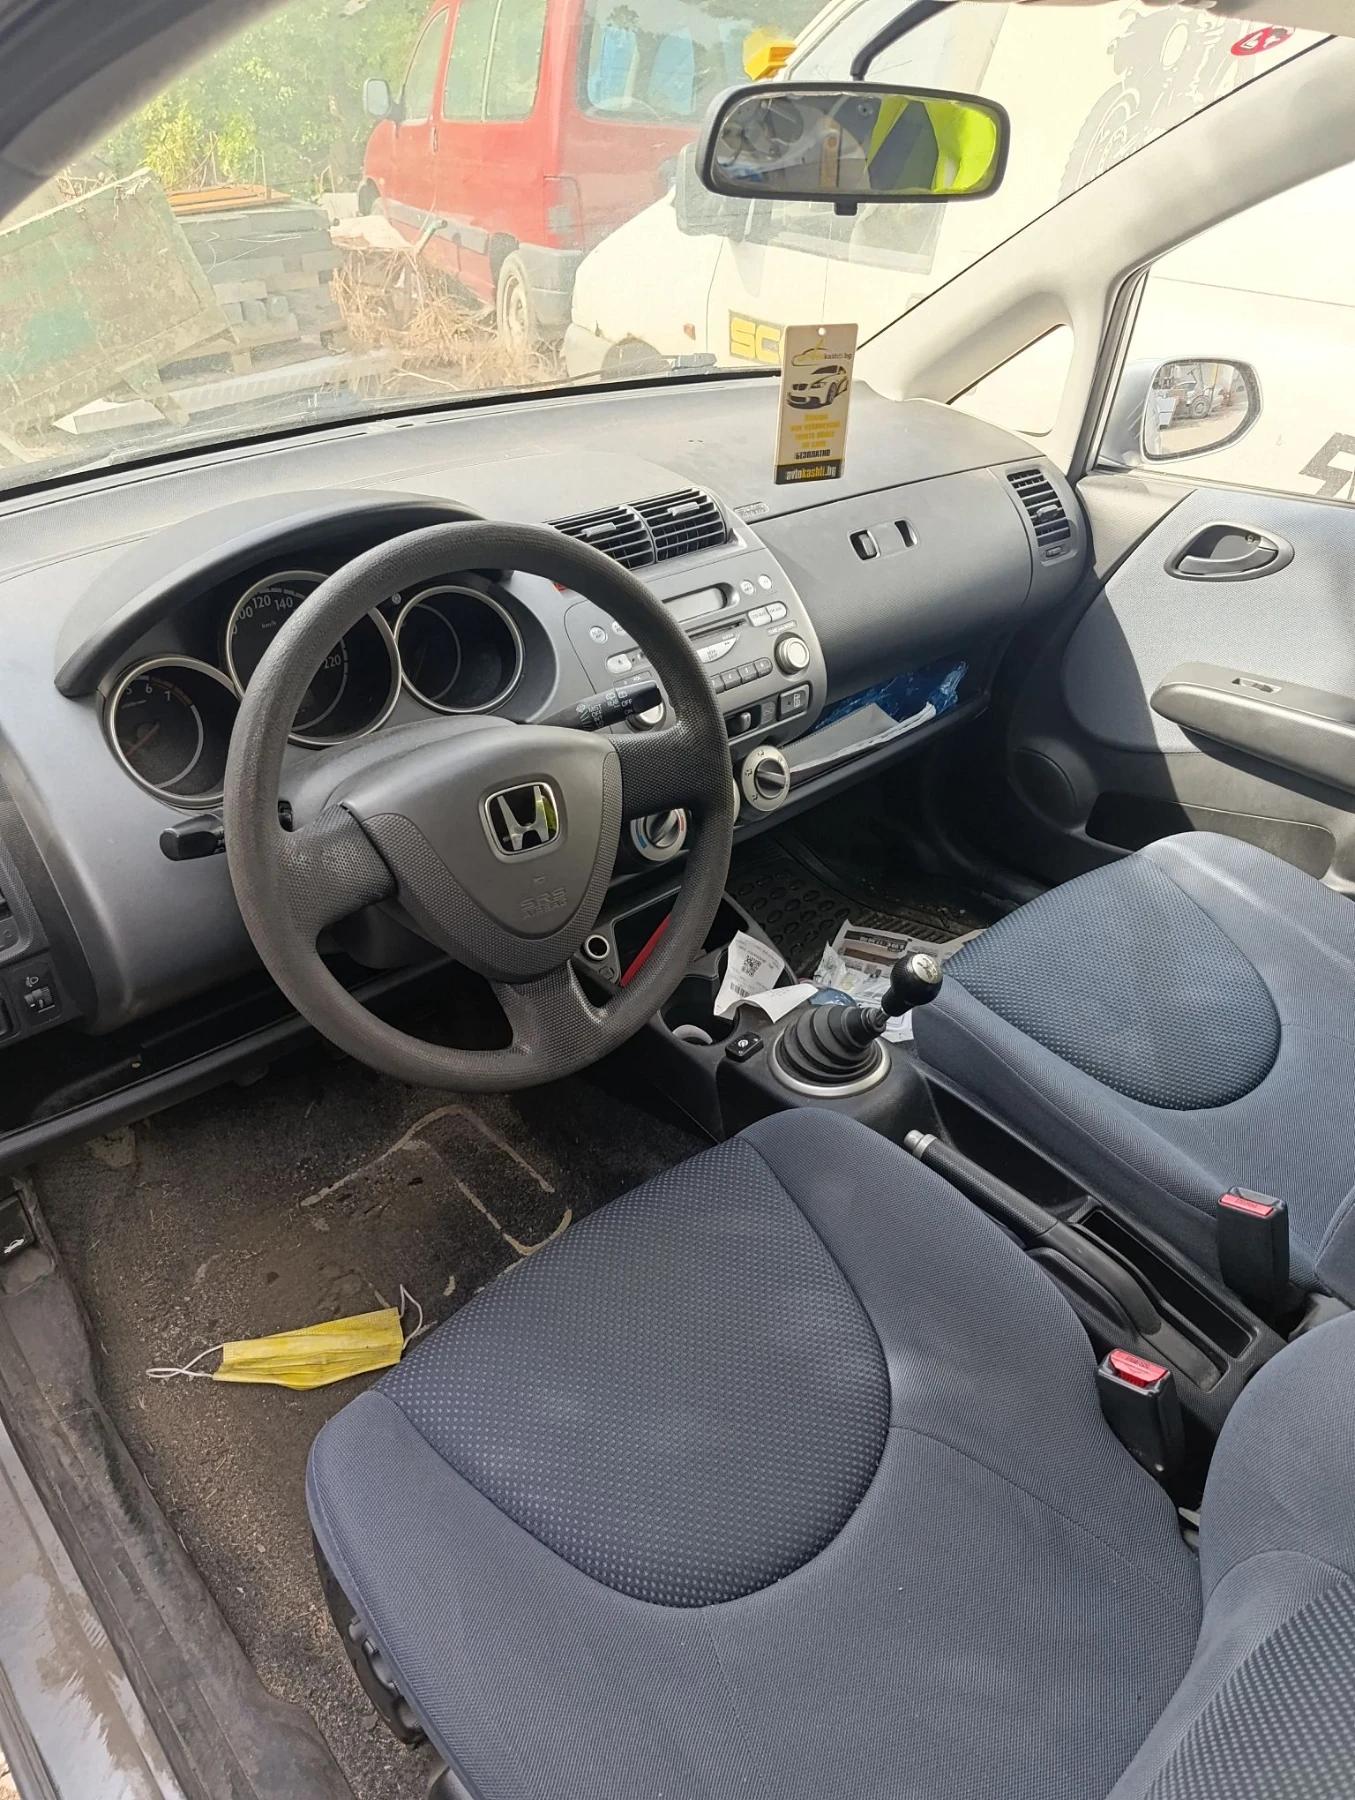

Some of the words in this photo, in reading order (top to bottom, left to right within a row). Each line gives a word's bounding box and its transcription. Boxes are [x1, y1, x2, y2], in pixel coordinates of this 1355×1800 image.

[786, 465, 837, 481] avtokashti.bg
[252, 595, 271, 609] 120
[274, 596, 293, 611] 140
[236, 606, 253, 620] 00
[324, 654, 341, 669] 220
[145, 683, 153, 694] 6
[621, 699, 633, 707] OFF
[521, 887, 566, 911] SRS
